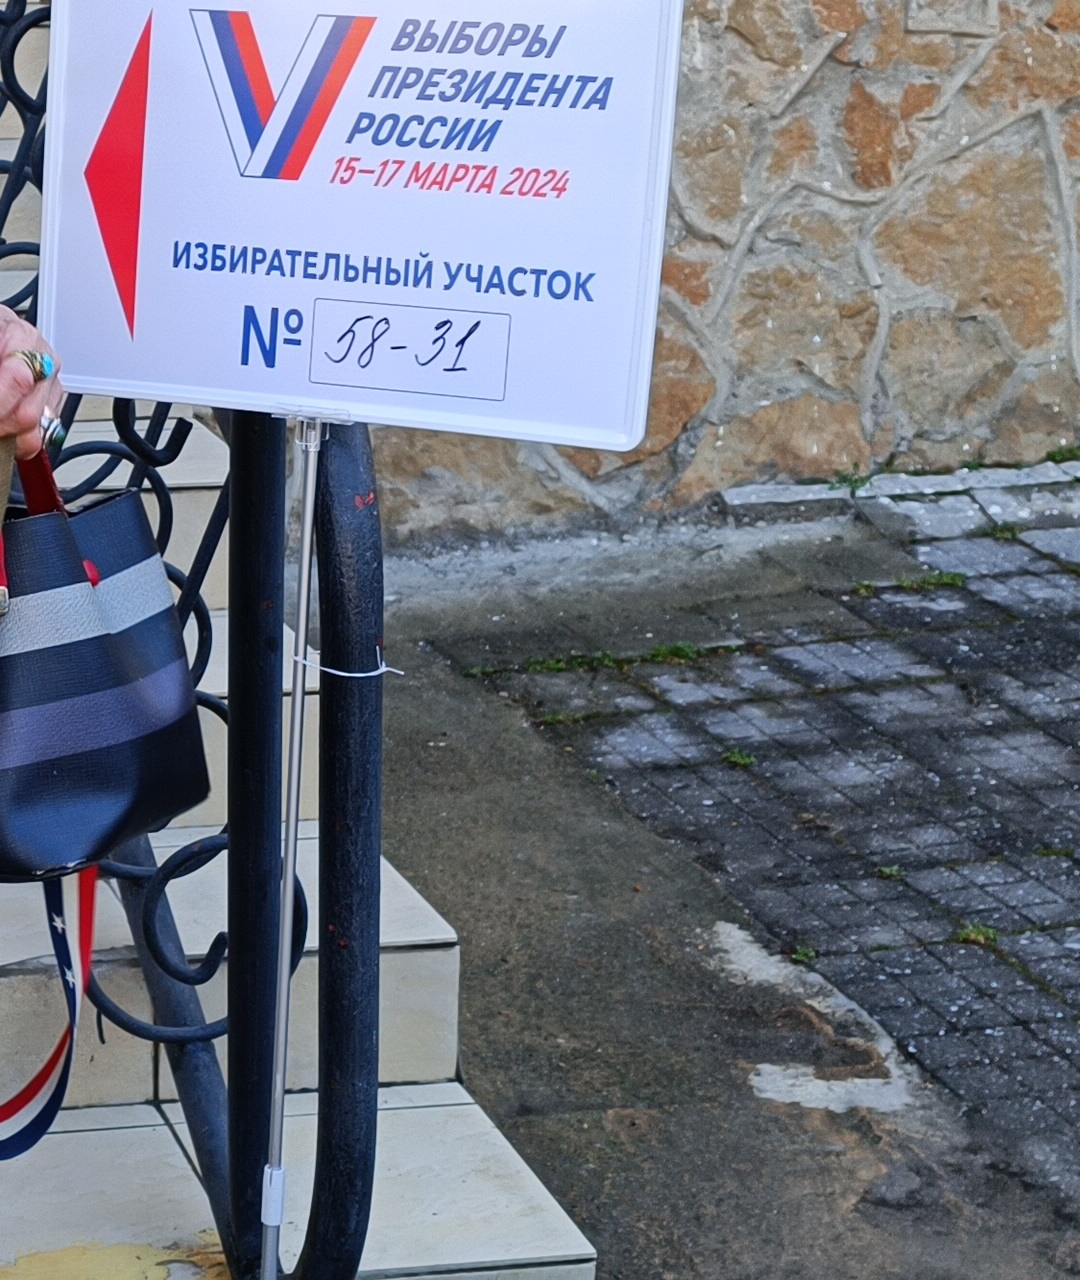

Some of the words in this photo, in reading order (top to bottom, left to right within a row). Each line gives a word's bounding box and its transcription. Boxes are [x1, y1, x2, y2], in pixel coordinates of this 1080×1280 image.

[390, 18, 568, 60] ВЫБОРЫ
[367, 65, 614, 111] ПРЕЗИДЕНТА
[345, 112, 504, 153] РОССИИ
[404, 159, 499, 195] МАРТА
[500, 166, 571, 200] 2024
[172, 239, 434, 289] ИЗБИРАТЕЛЬНЫЙ
[443, 261, 597, 302] УЧАСТОК
[240, 304, 304, 369] №
[324, 314, 482, 372] 58-31
